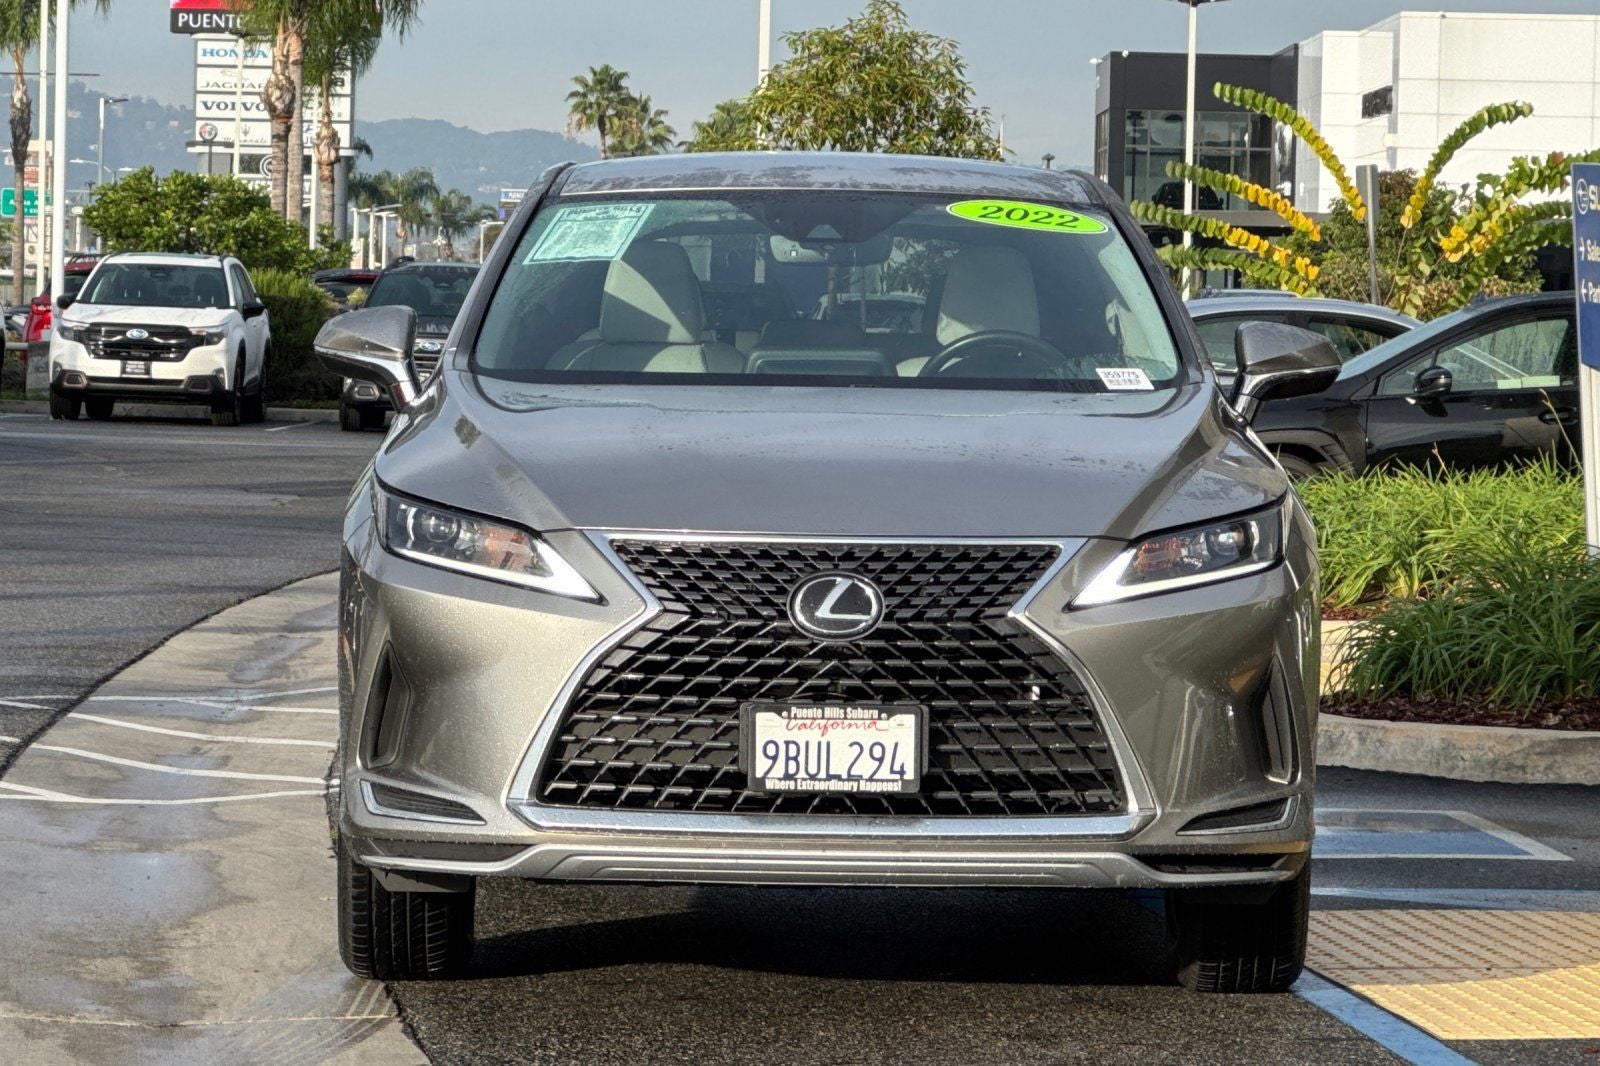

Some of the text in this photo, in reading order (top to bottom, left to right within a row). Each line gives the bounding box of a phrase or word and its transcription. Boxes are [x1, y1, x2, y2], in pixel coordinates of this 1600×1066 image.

[202, 48, 268, 58] HONDA
[202, 101, 267, 112] VOLVO
[977, 205, 1080, 229] 2022
[790, 706, 879, 719] Puente Hills Subaru
[786, 718, 889, 737] California
[762, 739, 907, 780] 9BUL294
[765, 779, 902, 791] Where Extraordinary Happens!
